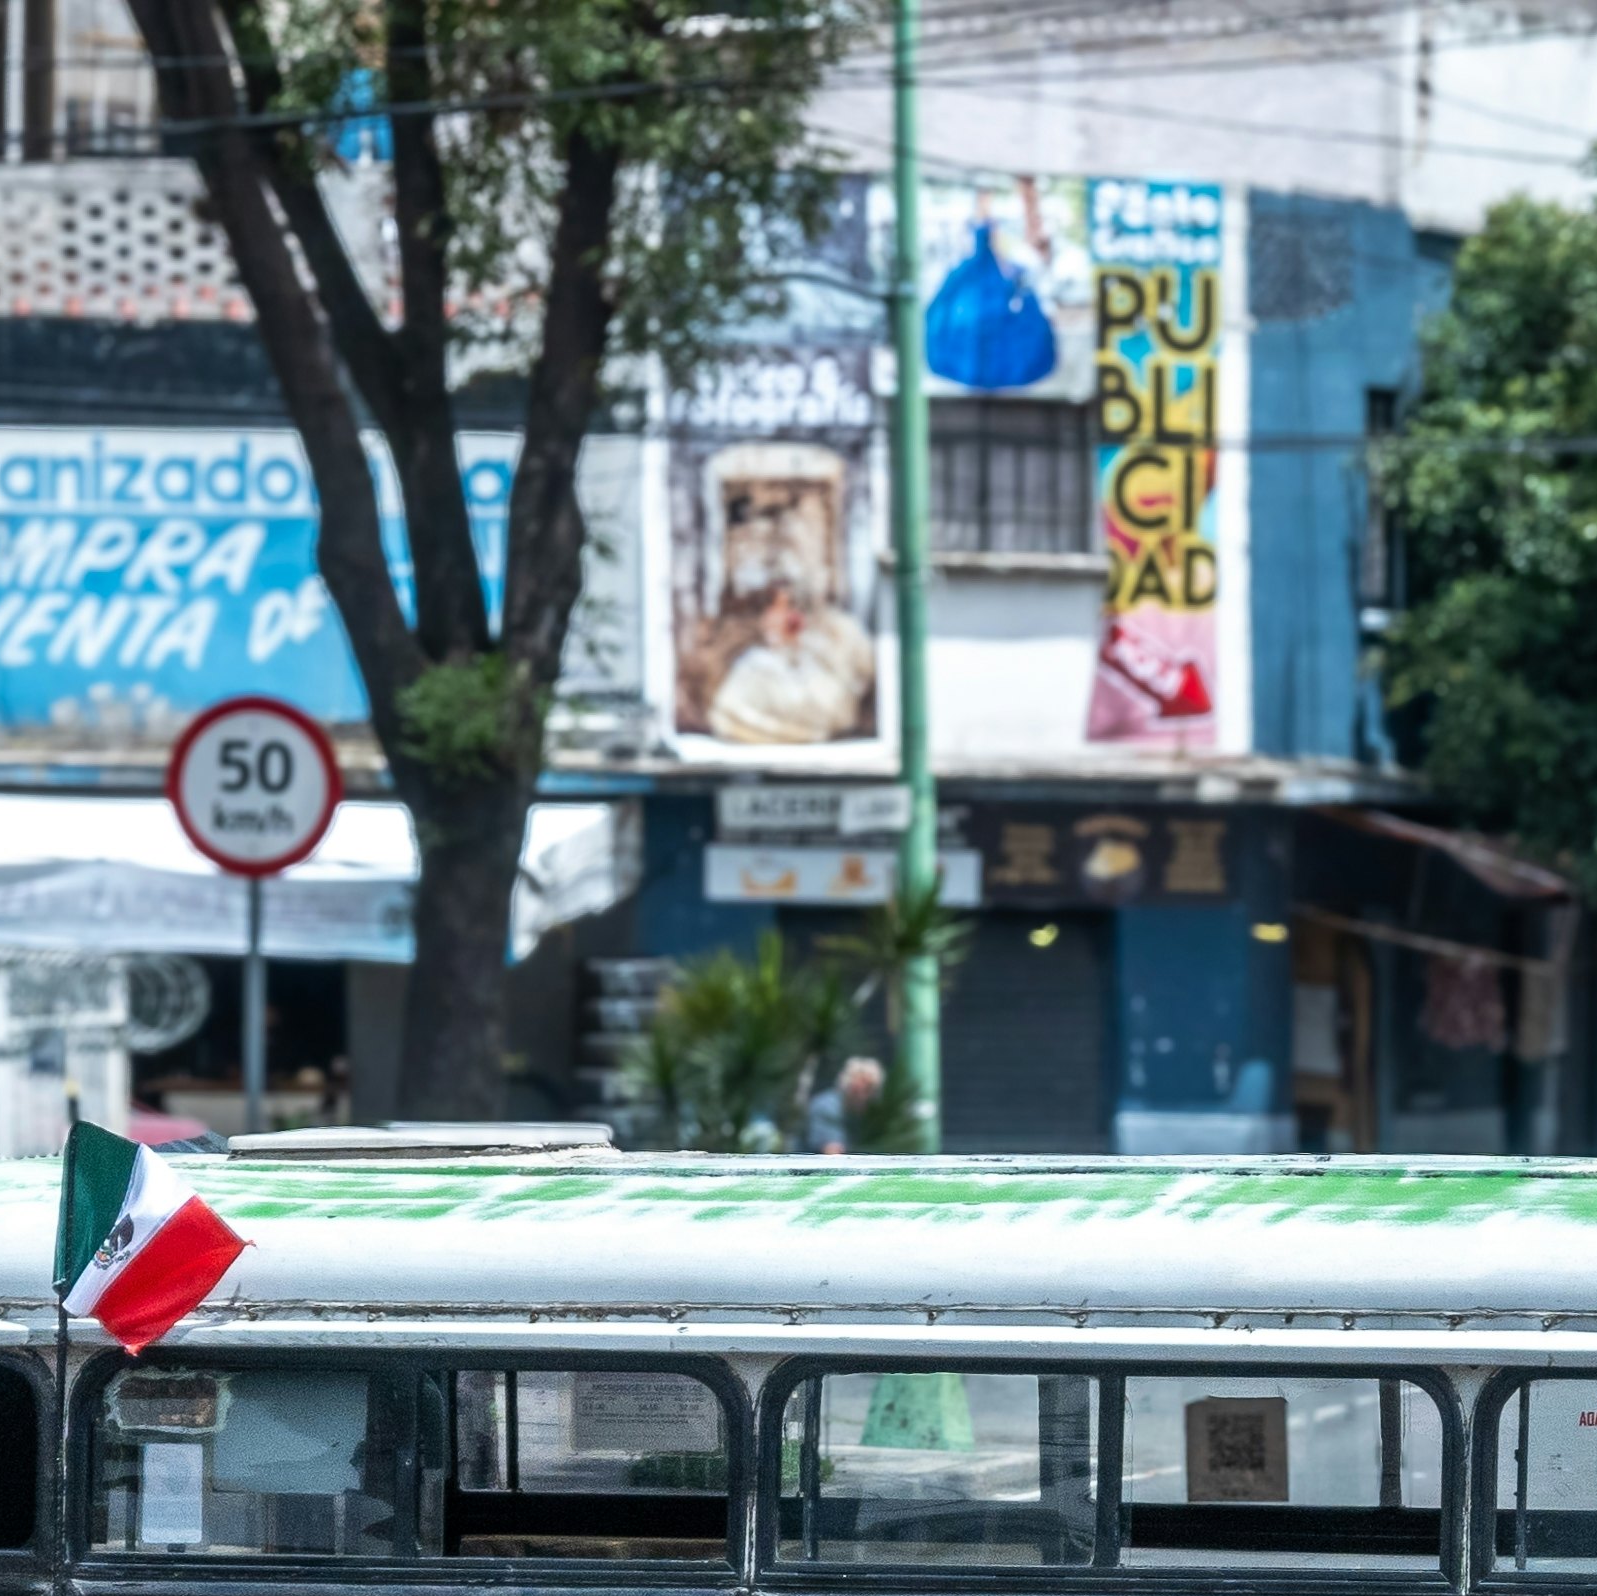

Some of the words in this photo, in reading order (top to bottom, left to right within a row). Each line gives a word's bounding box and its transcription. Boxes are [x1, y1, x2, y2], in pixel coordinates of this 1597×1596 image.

[1099, 272, 1213, 352] PU
[1100, 364, 1215, 449] BLI
[1114, 453, 1194, 530] CI
[219, 739, 294, 795] 50
[212, 801, 295, 836] km/h
